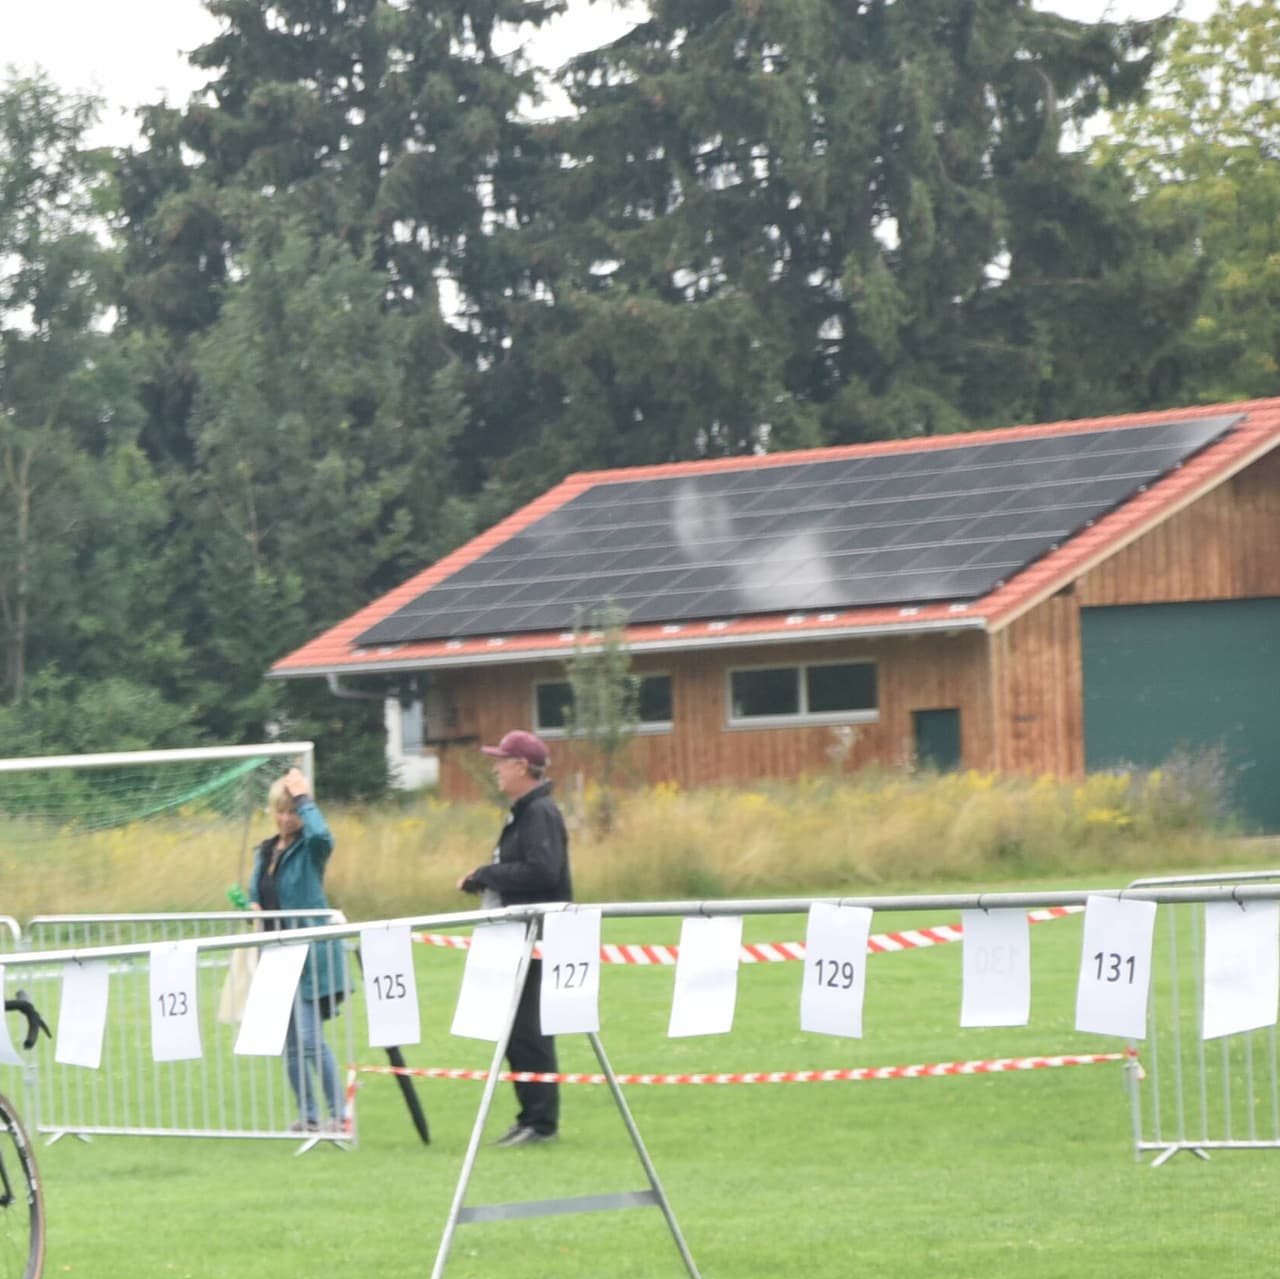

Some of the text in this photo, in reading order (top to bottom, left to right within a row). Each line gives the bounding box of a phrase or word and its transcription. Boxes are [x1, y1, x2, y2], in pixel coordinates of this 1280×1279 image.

[553, 961, 589, 990] 127
[815, 959, 854, 990] 129
[1094, 951, 1135, 985] 131
[373, 973, 406, 1000] 125
[158, 991, 188, 1017] 123
